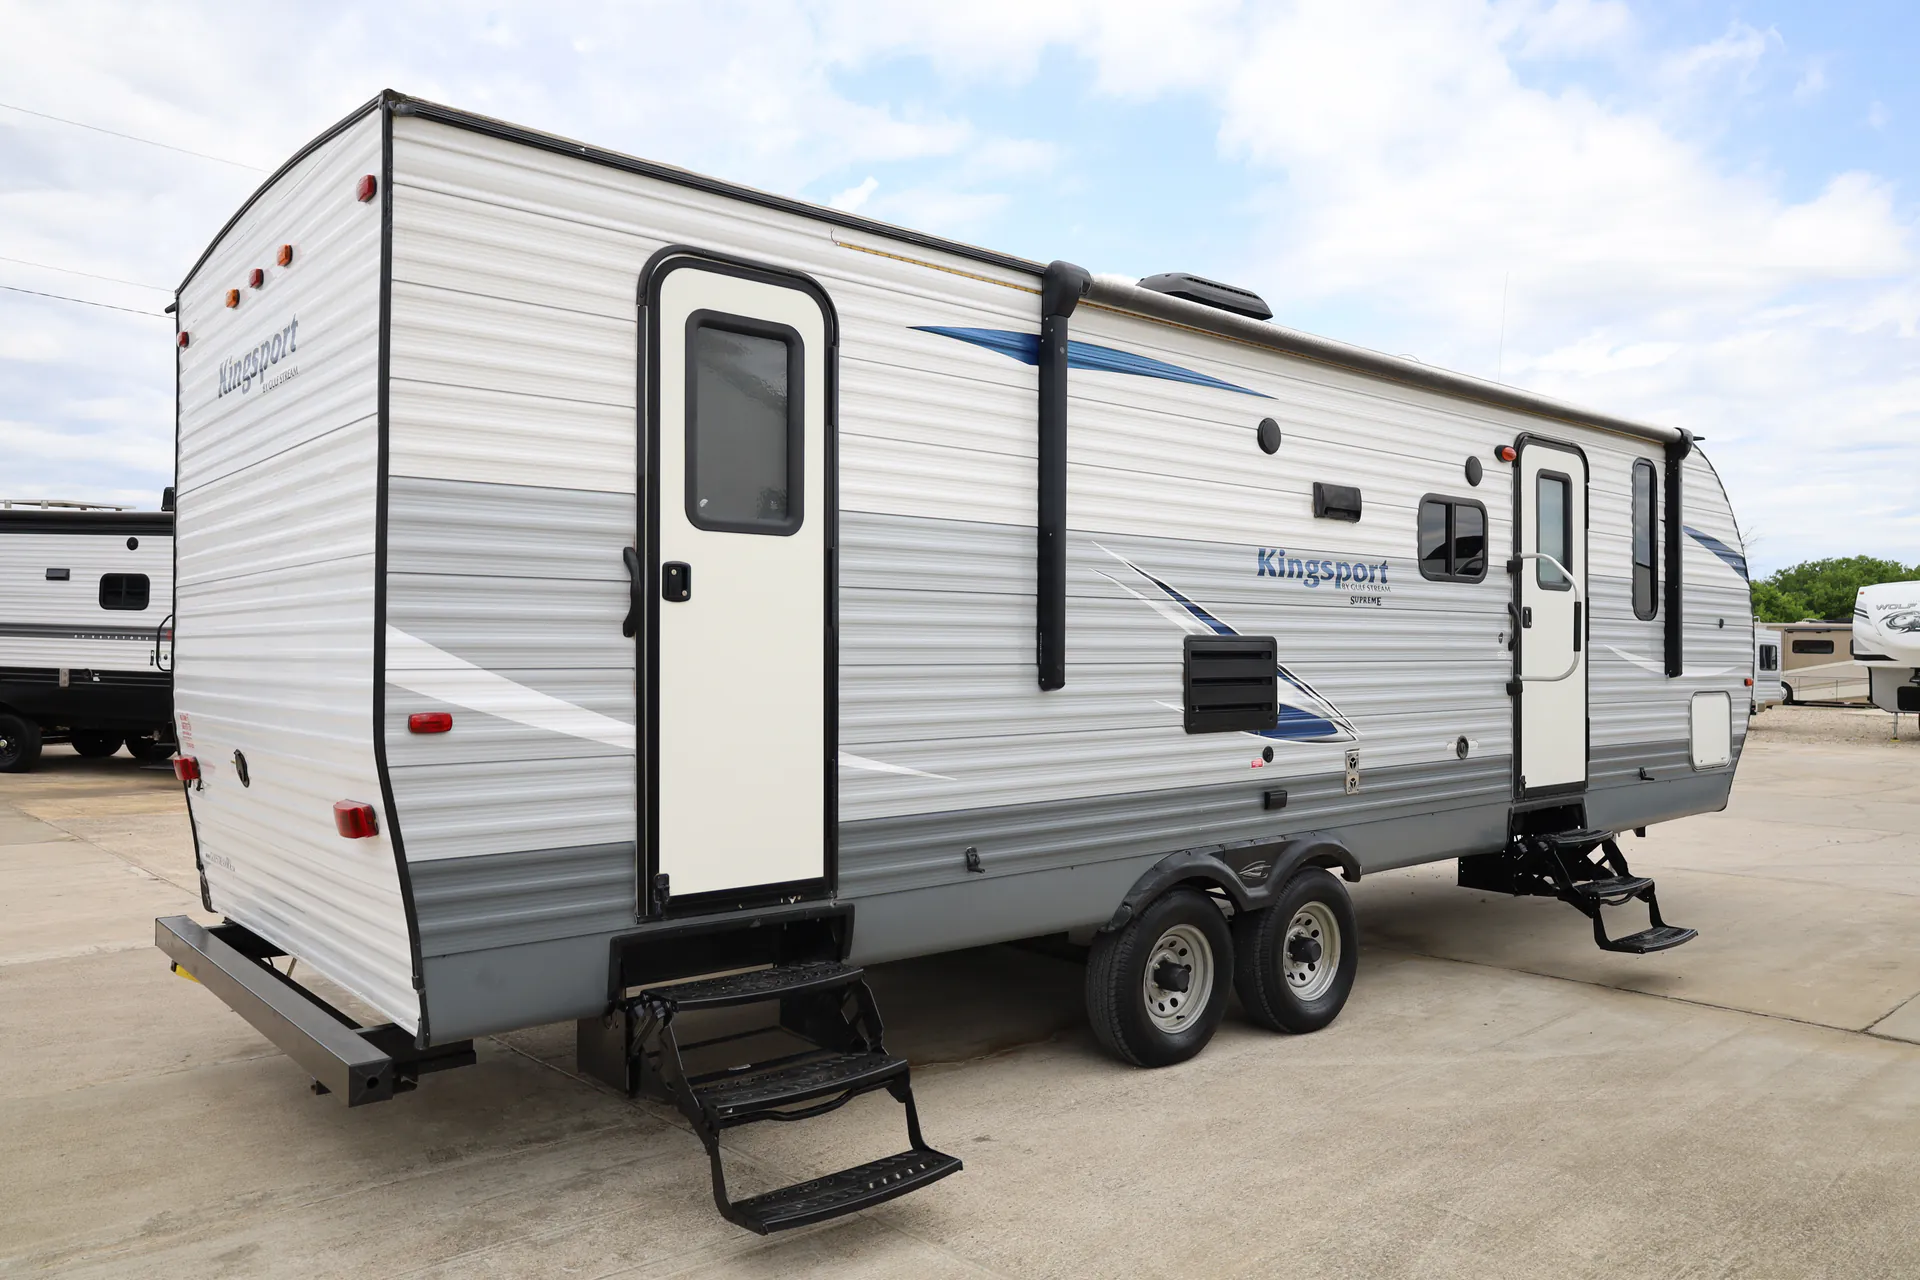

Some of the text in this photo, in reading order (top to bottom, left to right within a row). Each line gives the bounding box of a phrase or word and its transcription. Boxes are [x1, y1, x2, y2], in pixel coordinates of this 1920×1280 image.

[218, 312, 299, 399] Kingsport
[279, 366, 299, 384] STREAM
[1257, 547, 1389, 589] Kingsport
[1350, 583, 1366, 591] GULF
[1366, 584, 1392, 593] STREAM
[1350, 595, 1382, 606] SUPREME
[1875, 602, 1918, 611] WOLF
